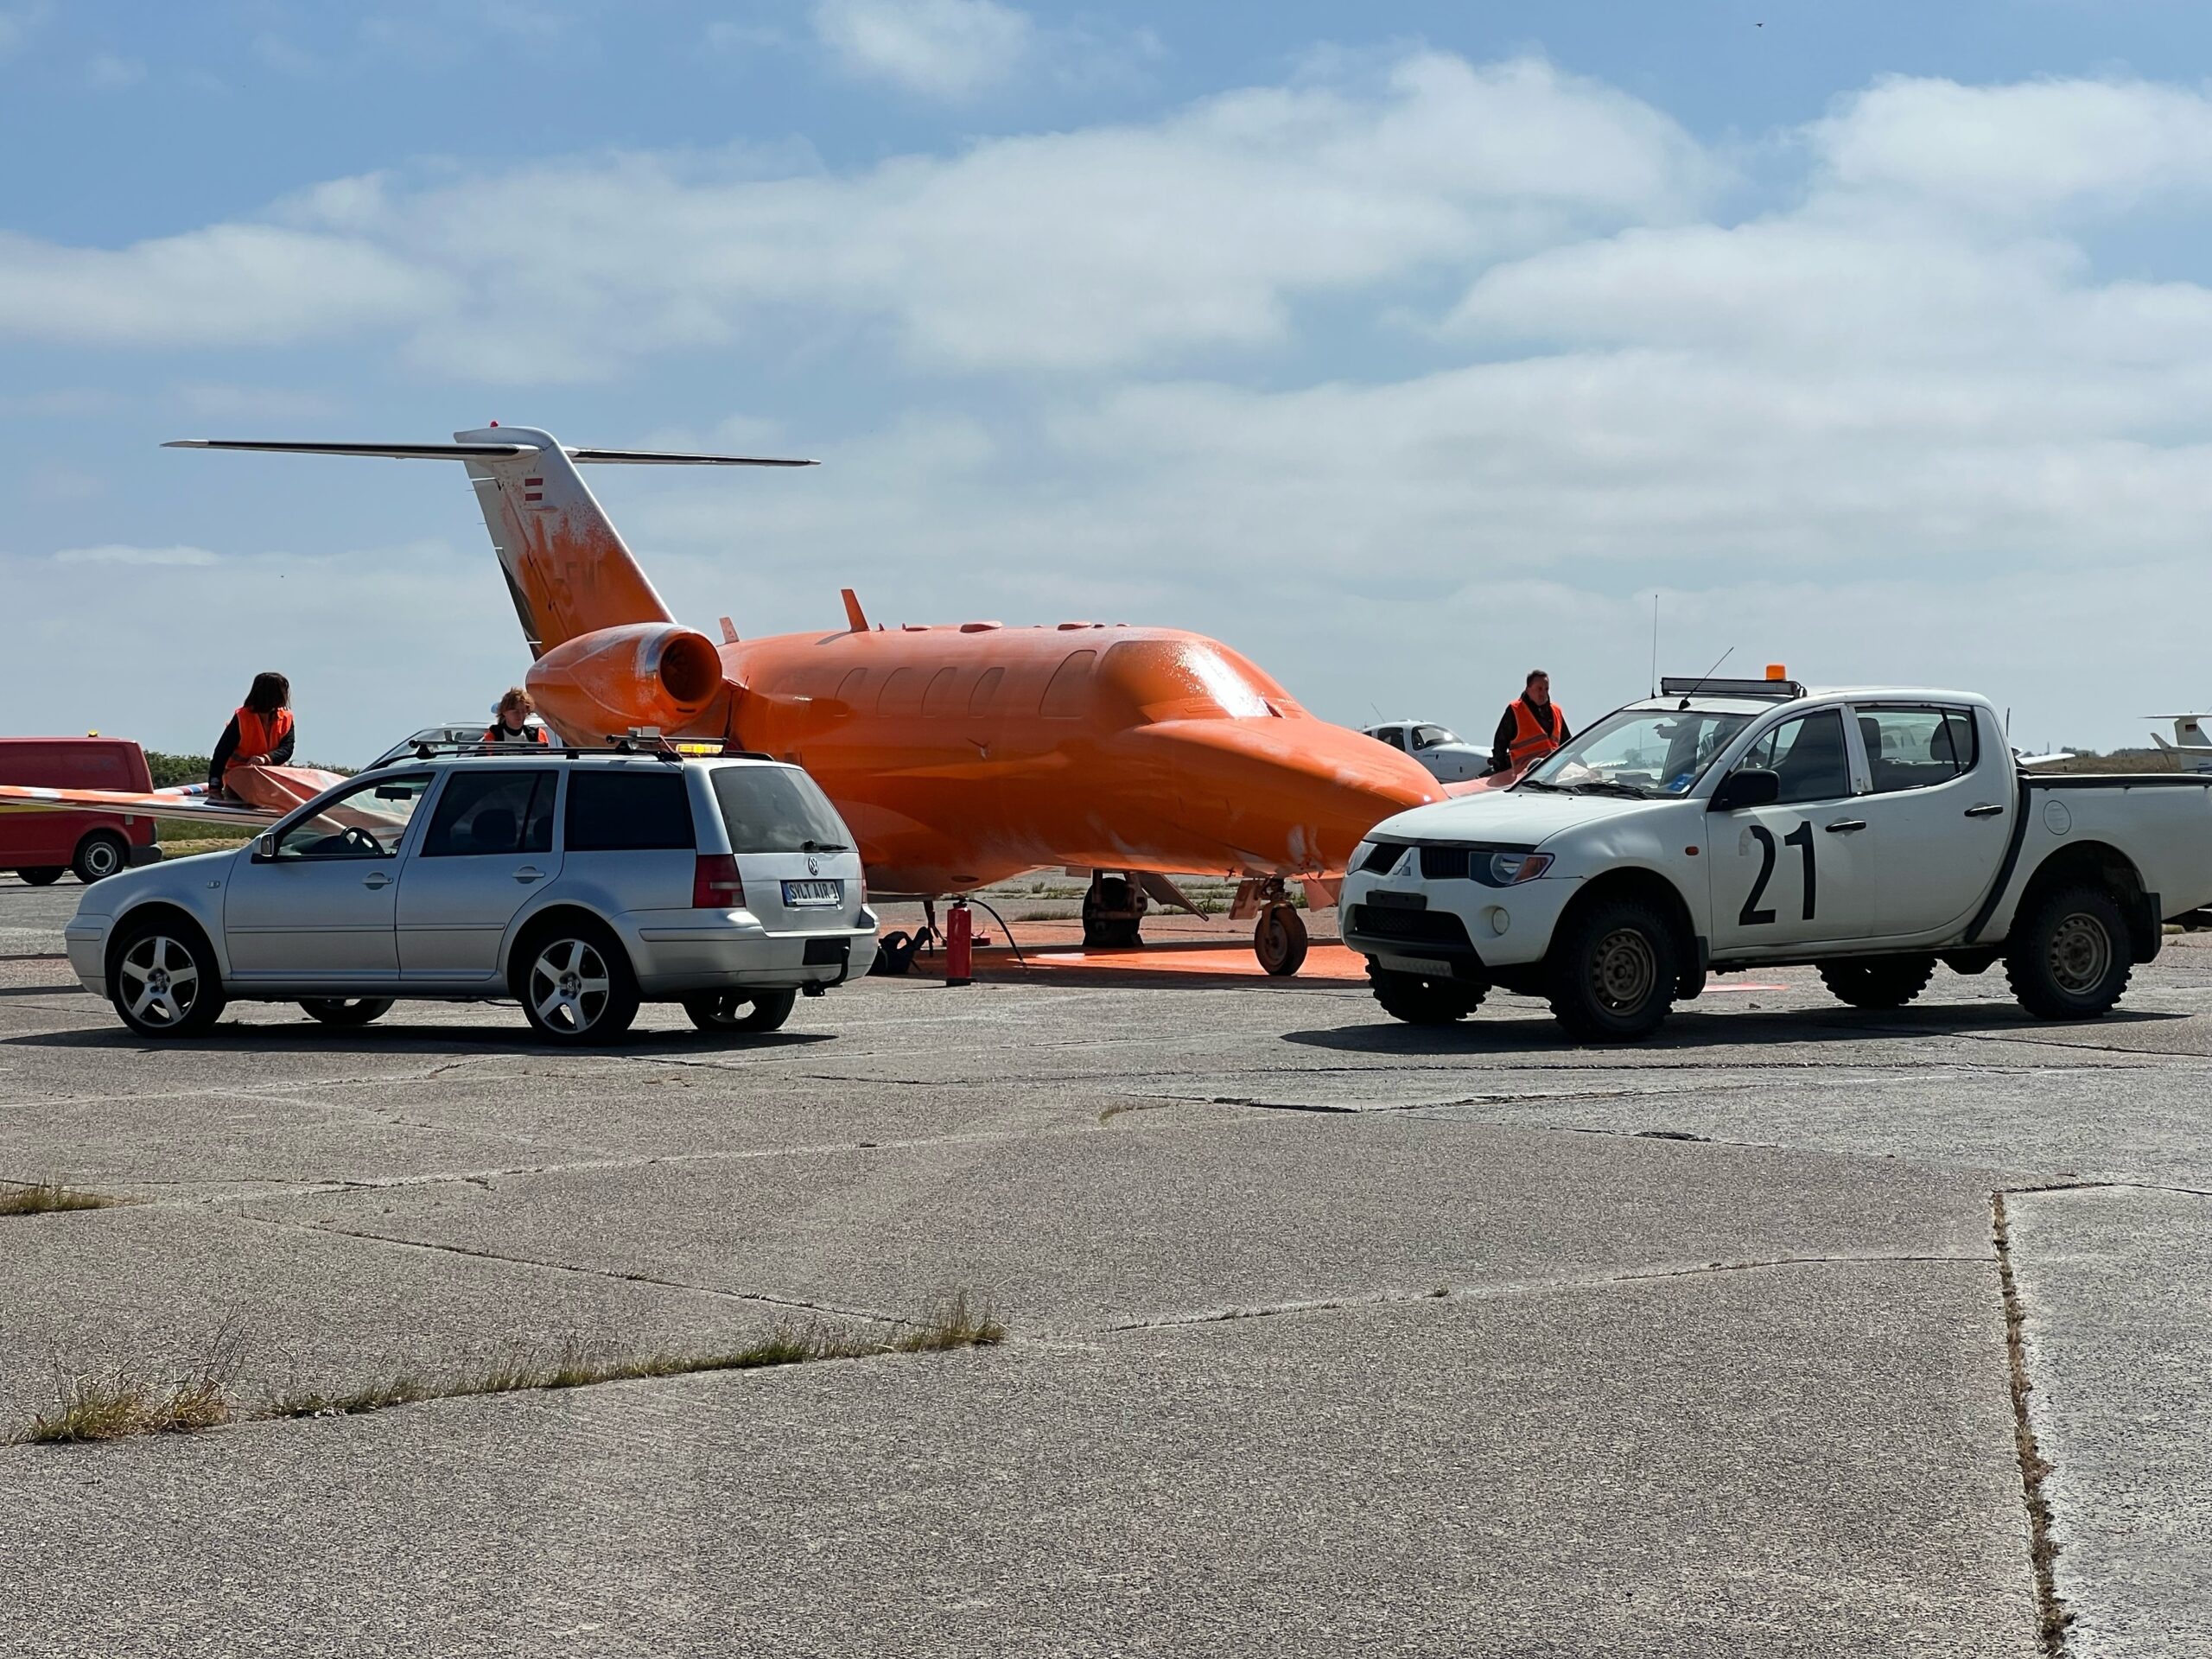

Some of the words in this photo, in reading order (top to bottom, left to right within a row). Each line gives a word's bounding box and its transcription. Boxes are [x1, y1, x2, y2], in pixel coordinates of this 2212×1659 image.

[789, 883, 811, 899] SYLT
[814, 883, 830, 899] AIR
[830, 883, 838, 899] 1
[1738, 821, 1816, 926] 21
